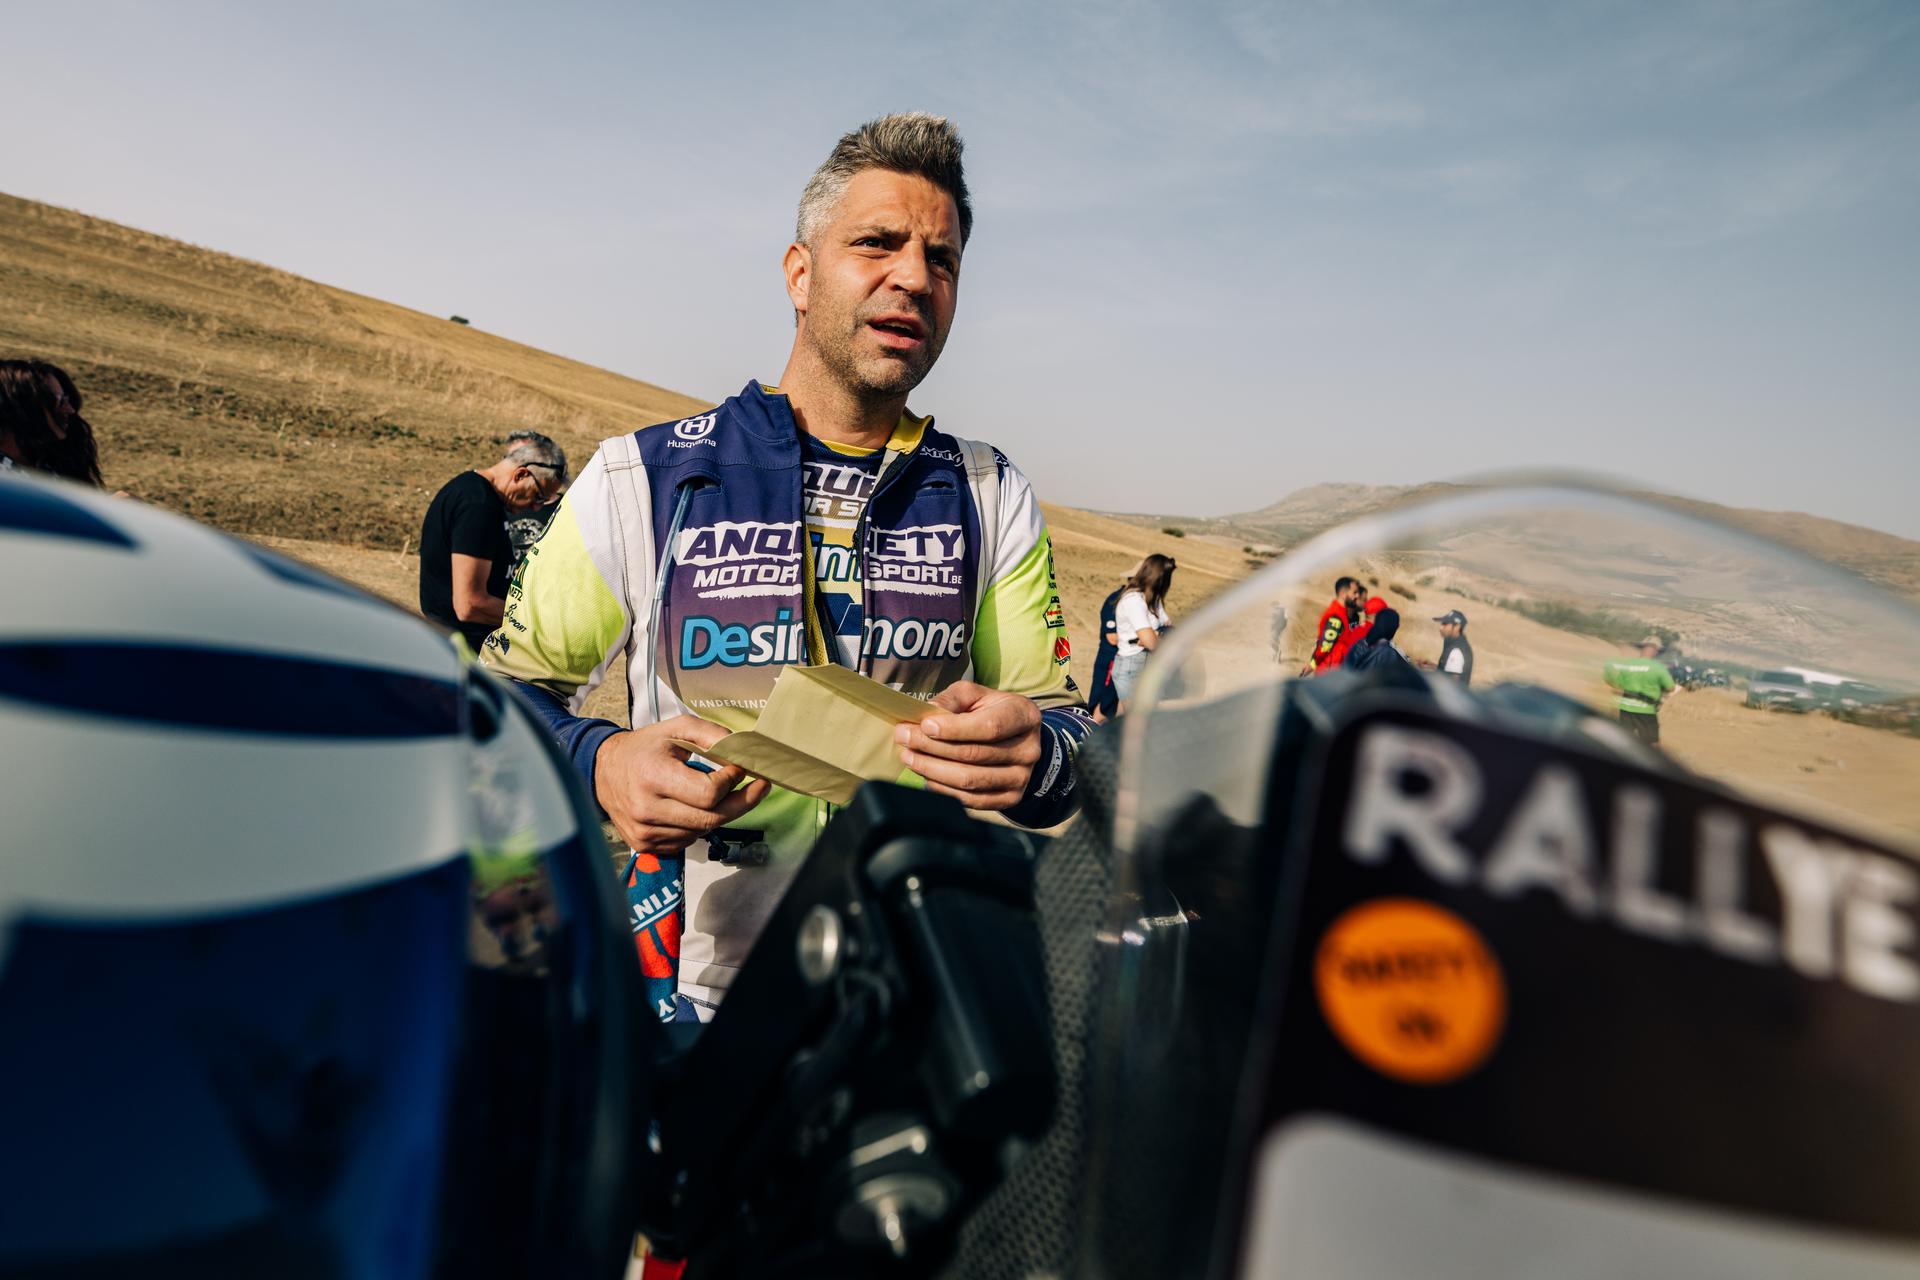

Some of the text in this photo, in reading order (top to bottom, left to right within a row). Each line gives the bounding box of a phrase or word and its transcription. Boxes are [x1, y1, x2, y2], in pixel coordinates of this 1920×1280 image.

[667, 439, 717, 449] Husqvarna
[693, 564, 800, 588] MOTOR
[1344, 724, 1920, 1002] RALLYE
